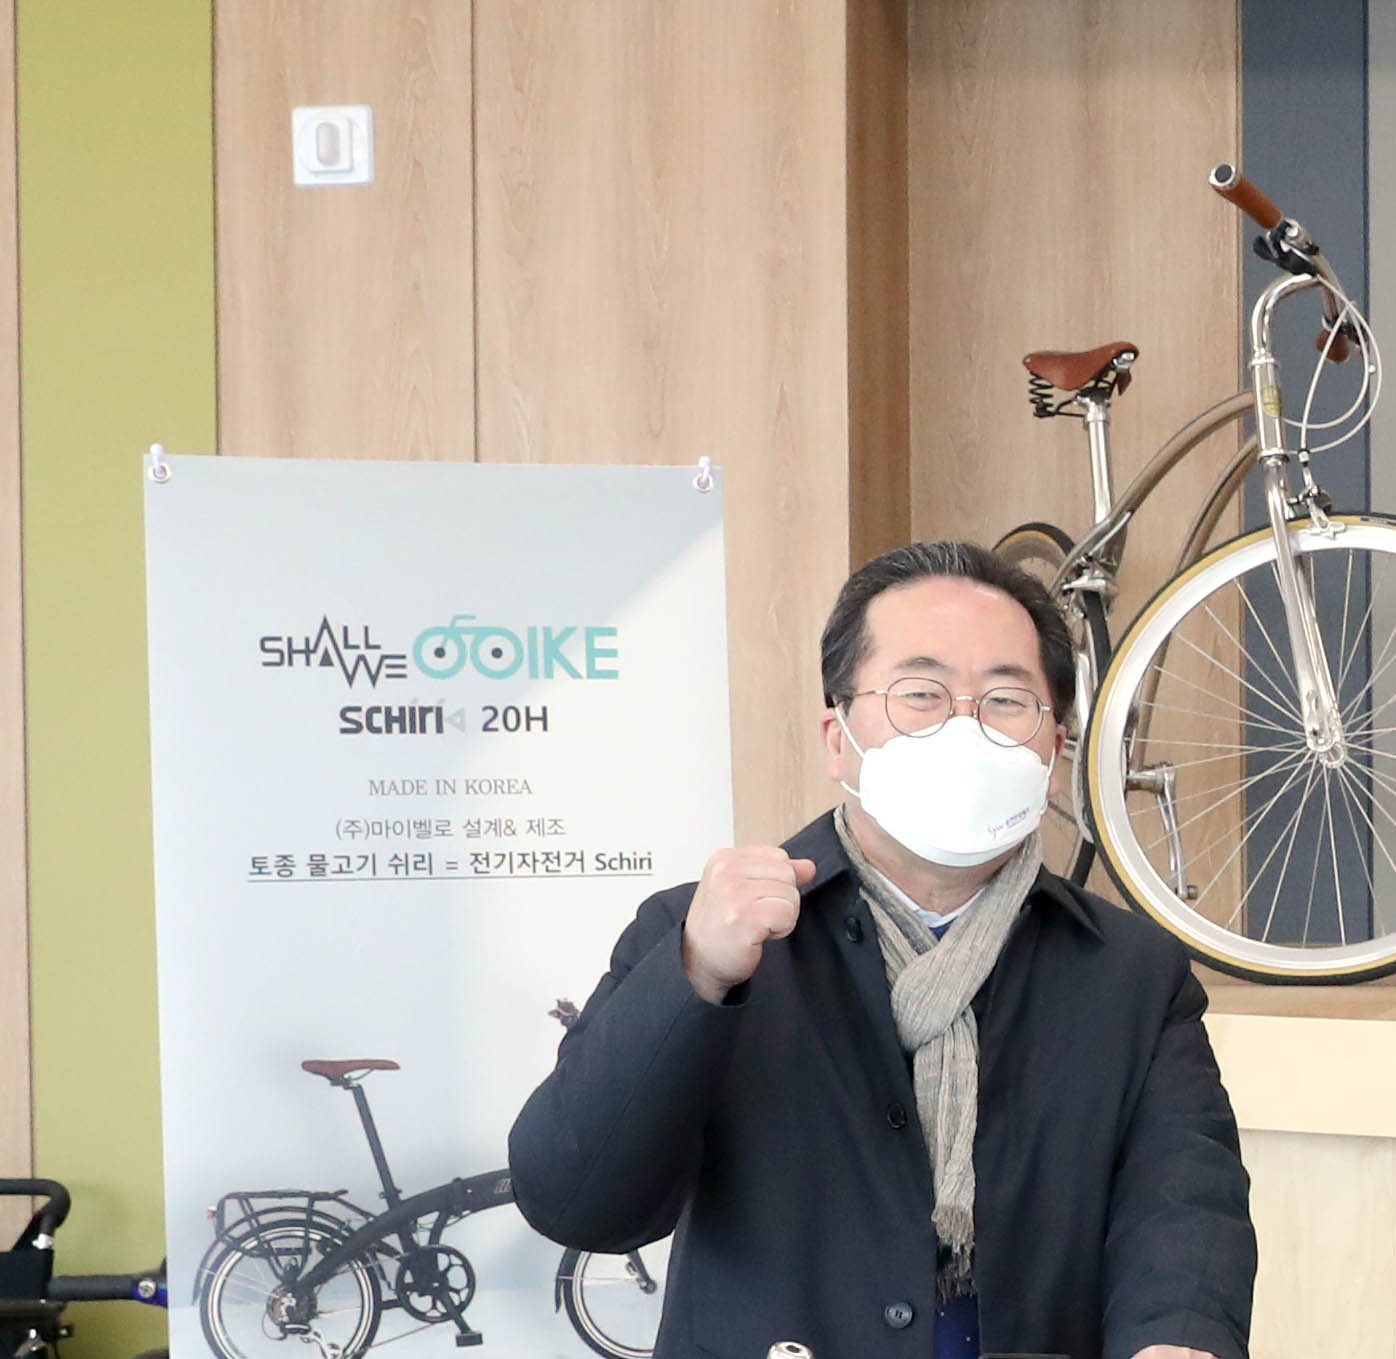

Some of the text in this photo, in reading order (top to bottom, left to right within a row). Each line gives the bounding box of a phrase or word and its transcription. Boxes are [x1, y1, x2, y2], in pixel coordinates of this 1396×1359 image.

[481, 705, 549, 733] 20H
[368, 777, 532, 797] MADE IN KOREA
[335, 819, 454, 842] (주)마이벨로
[525, 818, 566, 838] 제조
[248, 854, 297, 878] 토종
[306, 853, 377, 878] 물고기
[388, 853, 434, 877] 쉬리
[469, 851, 586, 876] 전기자전거
[595, 852, 653, 872] Schiri
